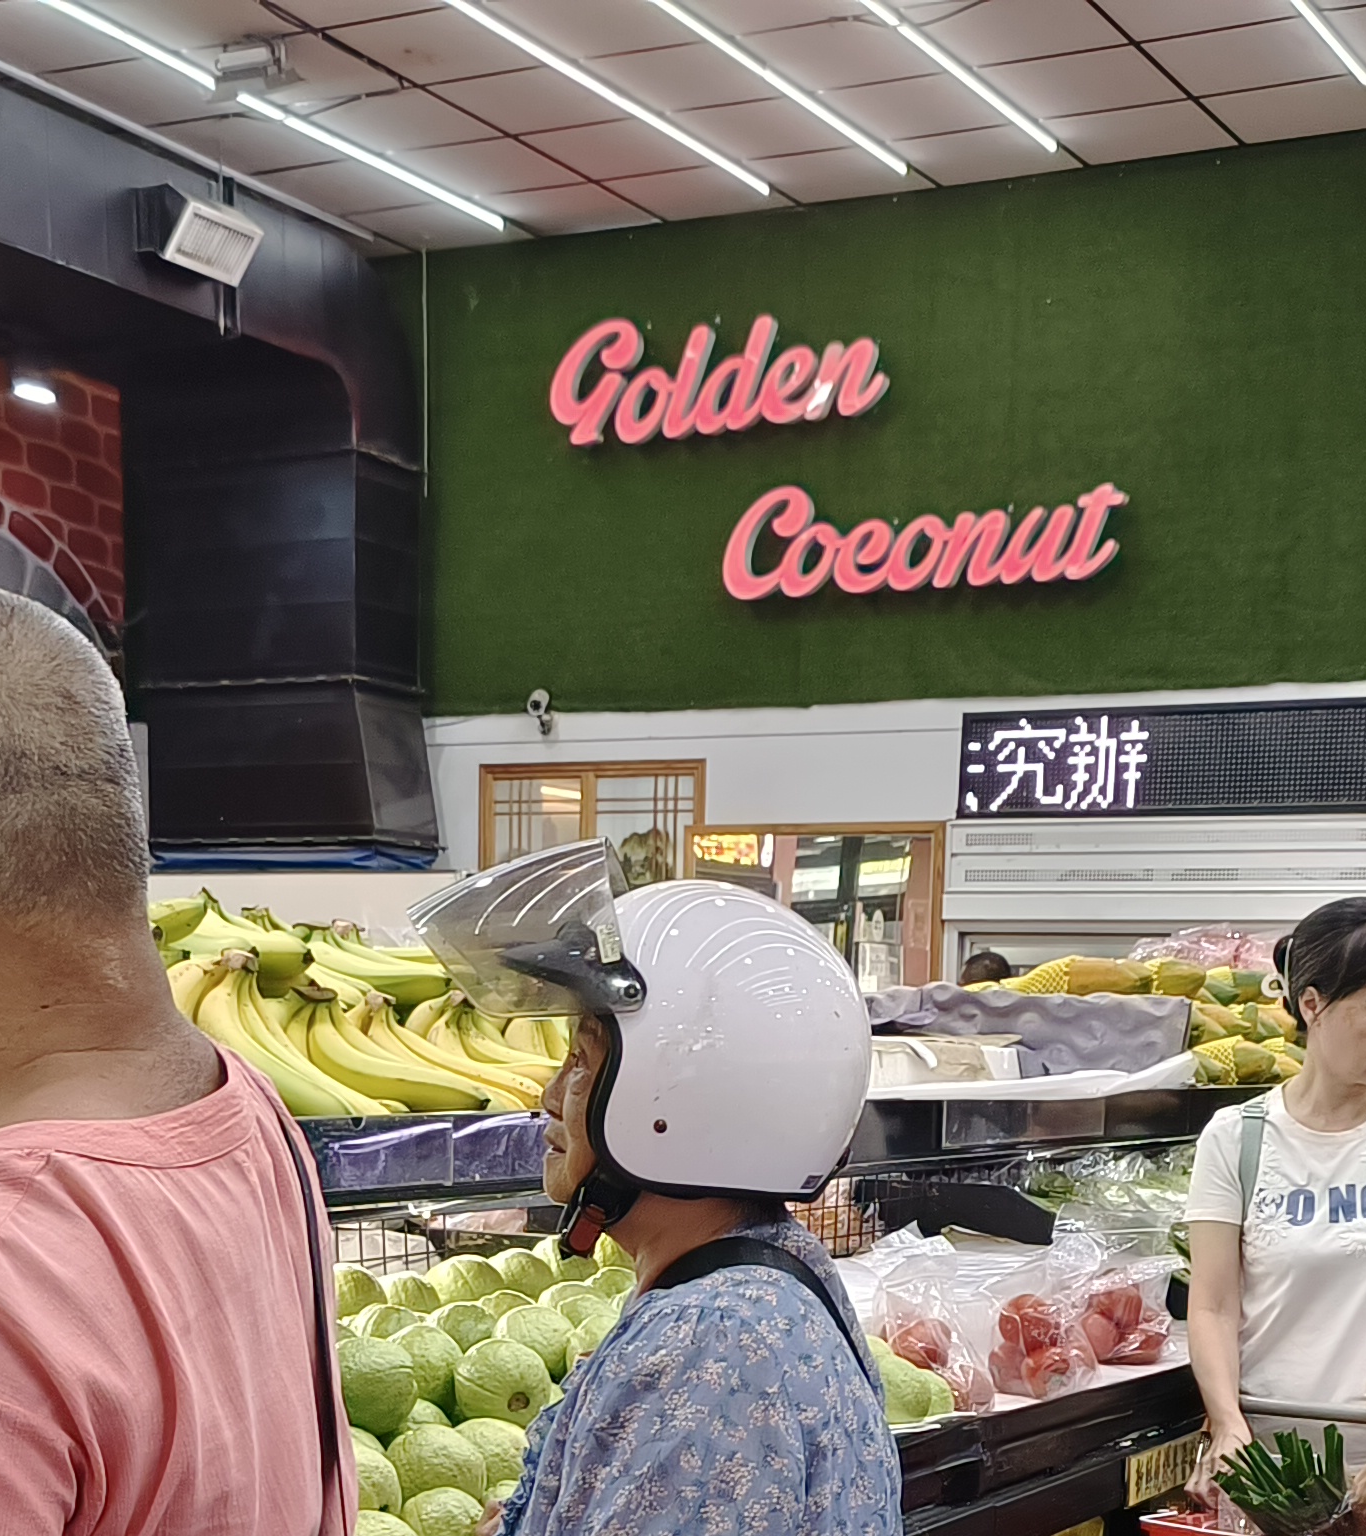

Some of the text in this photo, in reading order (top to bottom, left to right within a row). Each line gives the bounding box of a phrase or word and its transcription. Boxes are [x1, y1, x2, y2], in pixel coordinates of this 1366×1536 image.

[550, 314, 889, 445] Golden
[723, 483, 1129, 600] Coconut
[966, 715, 1149, 812] 究辦
